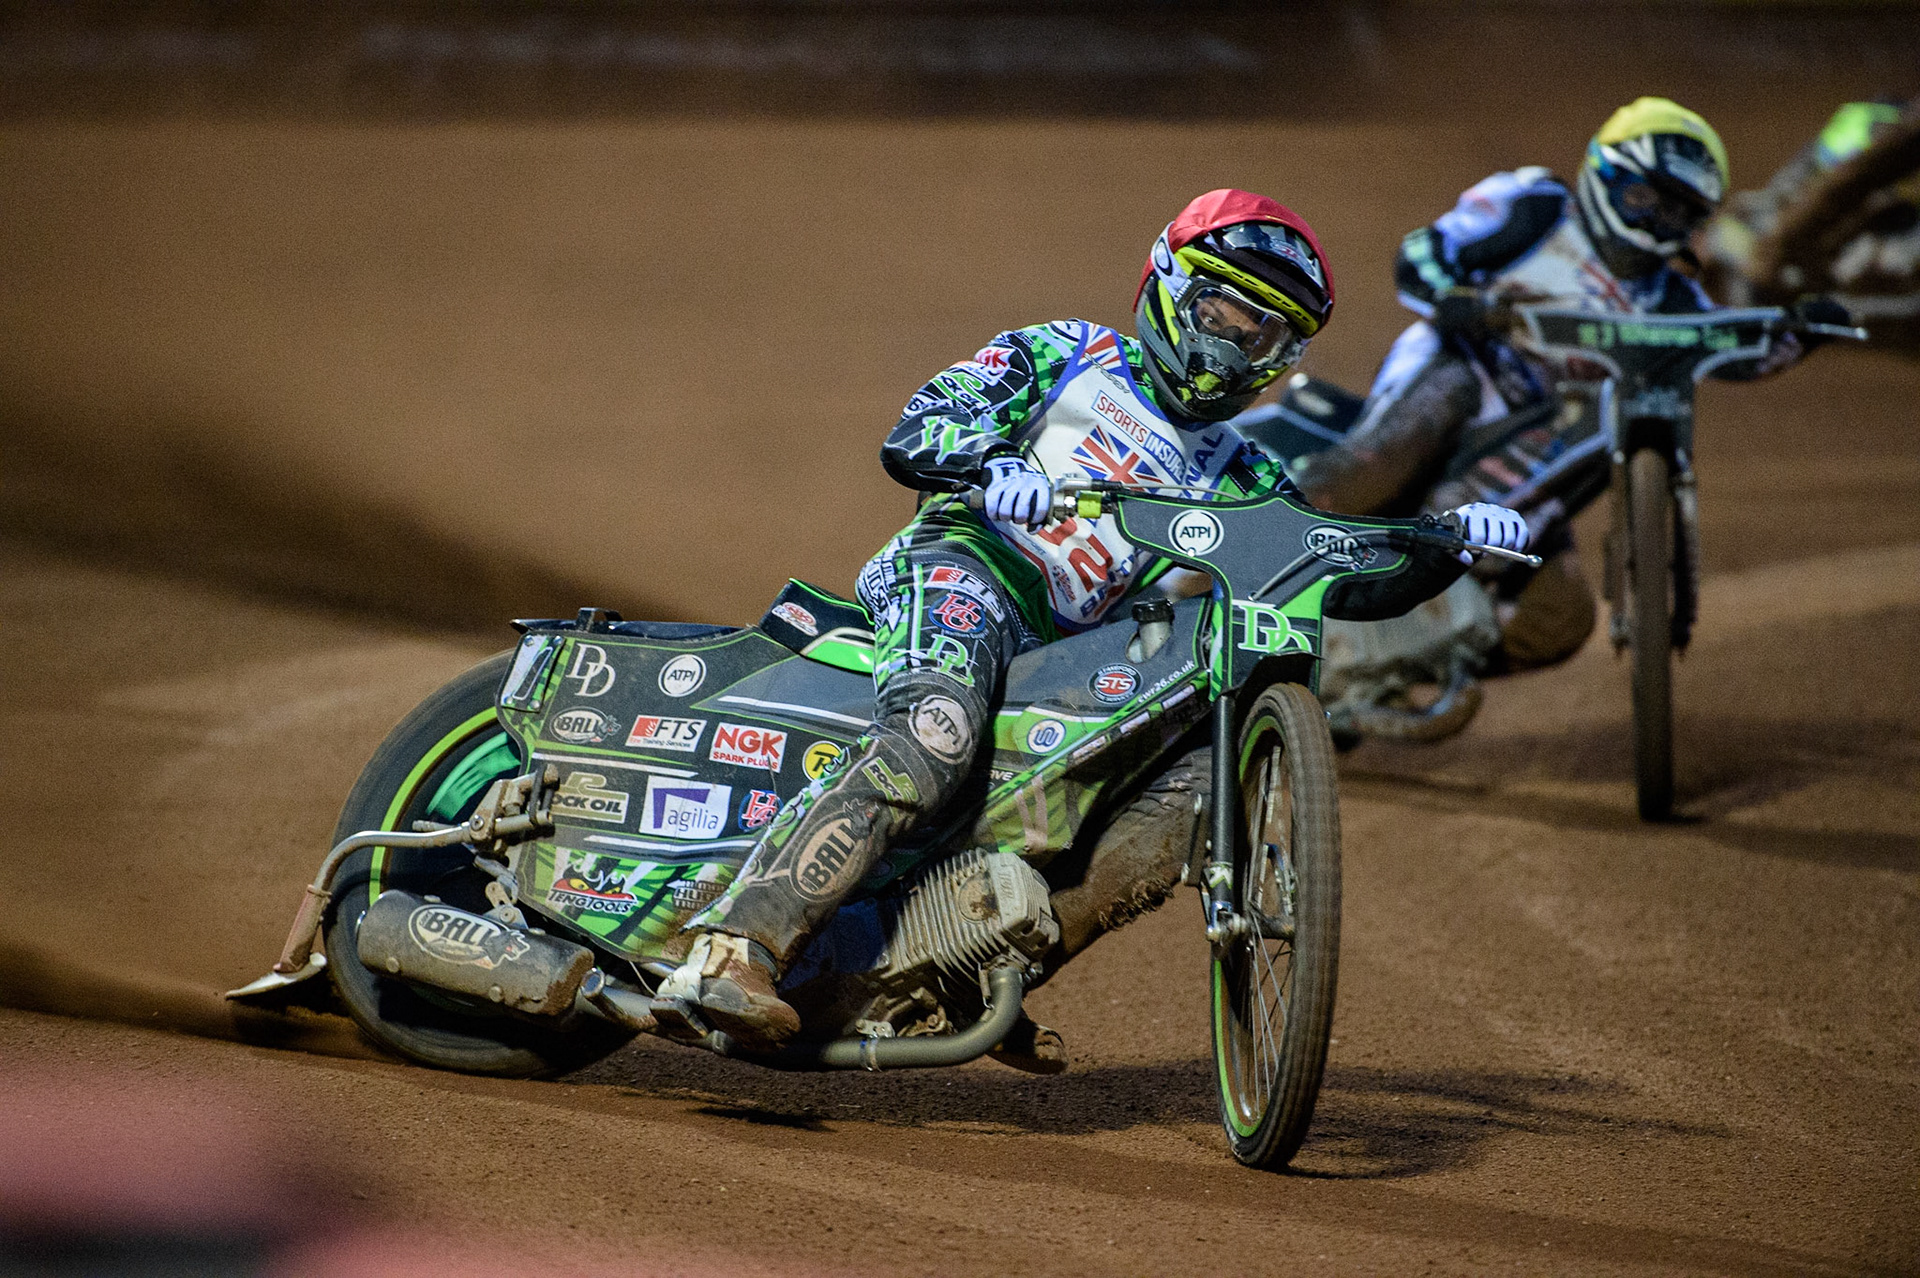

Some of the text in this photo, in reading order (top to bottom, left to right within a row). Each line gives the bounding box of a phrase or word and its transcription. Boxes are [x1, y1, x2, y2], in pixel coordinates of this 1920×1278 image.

[1097, 396, 1148, 443] SPORTS
[1179, 526, 1211, 539] ATPI
[565, 642, 617, 698] DD
[666, 669, 696, 683] ATPI
[1096, 676, 1134, 690] STS
[653, 719, 702, 740] FTS
[923, 707, 962, 746] ATPI
[714, 726, 784, 759] NGK
[713, 751, 779, 771] SPARK PLUGS
[868, 764, 901, 797] ROCK
[590, 799, 622, 813] OIL
[667, 806, 719, 832] agilia
